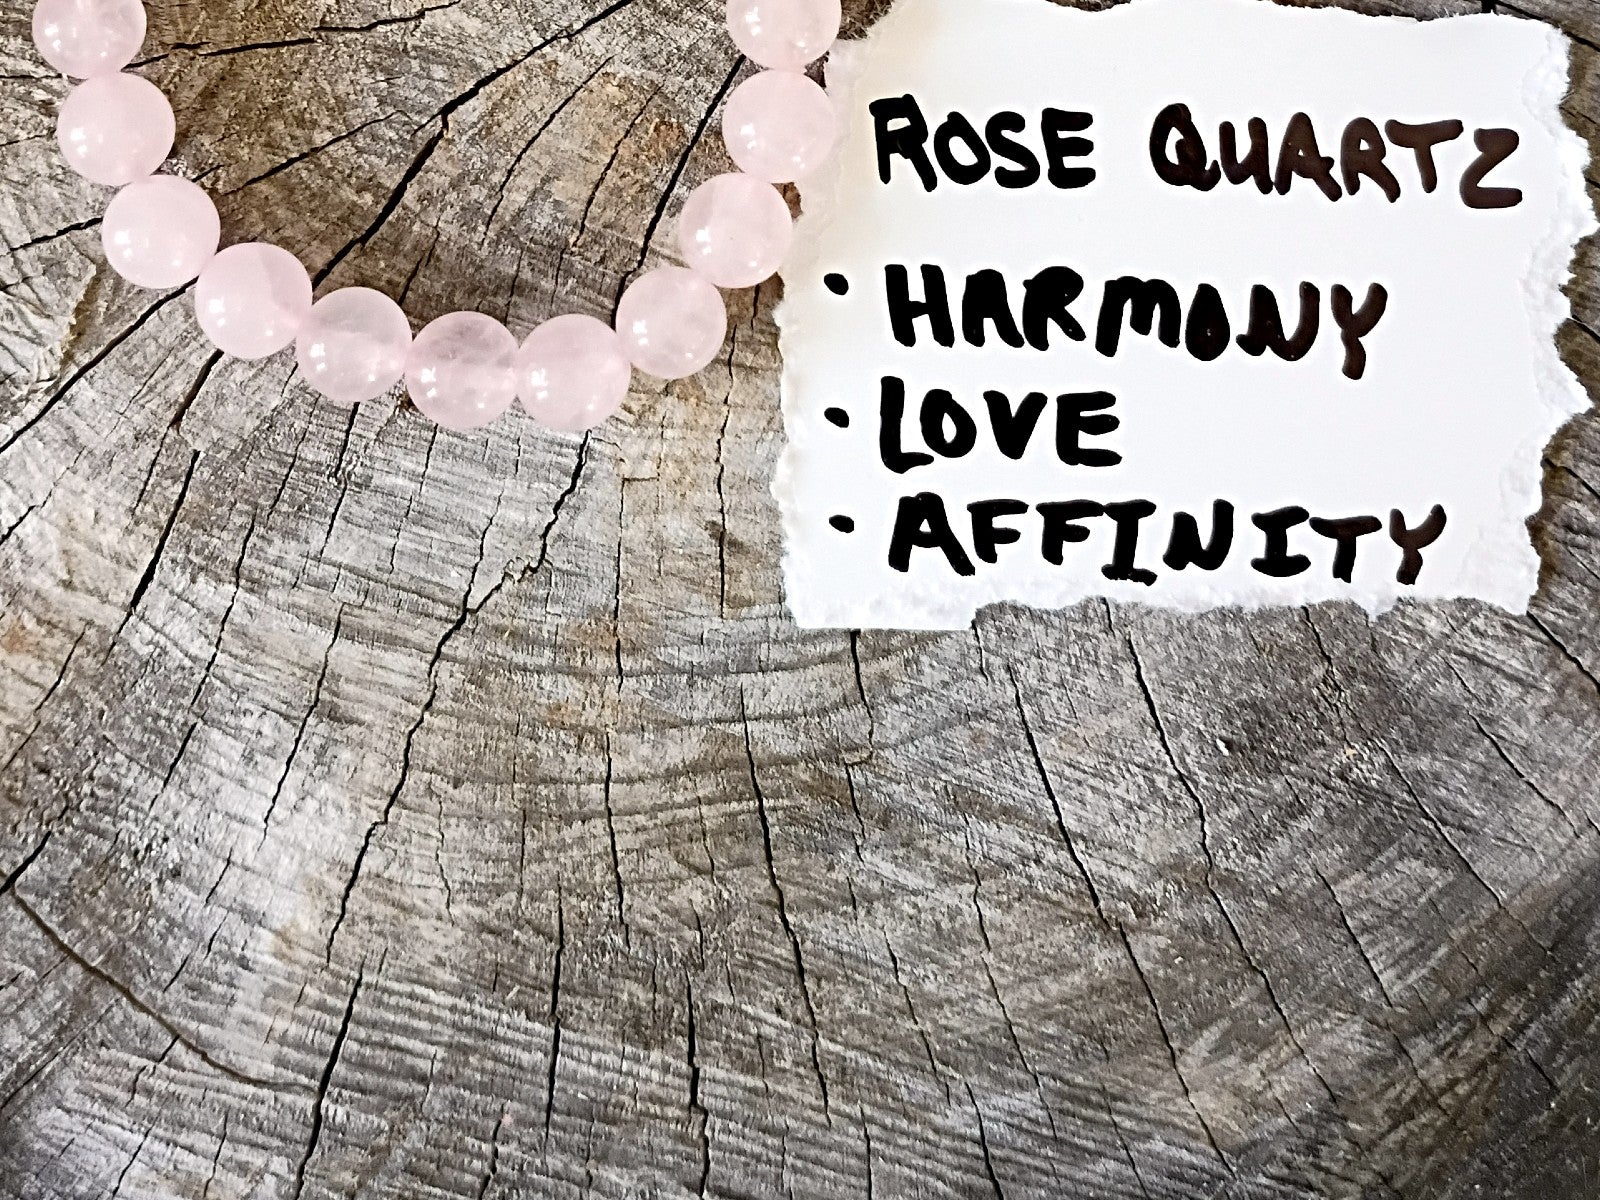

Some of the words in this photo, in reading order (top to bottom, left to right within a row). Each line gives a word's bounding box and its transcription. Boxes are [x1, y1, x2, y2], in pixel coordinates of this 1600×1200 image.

[868, 93, 1097, 192] ROSE
[1149, 102, 1523, 210] QUARTZ
[884, 263, 1389, 381] HARMONY
[879, 375, 1123, 475] LOVE
[887, 491, 1447, 587] AFFINITY
